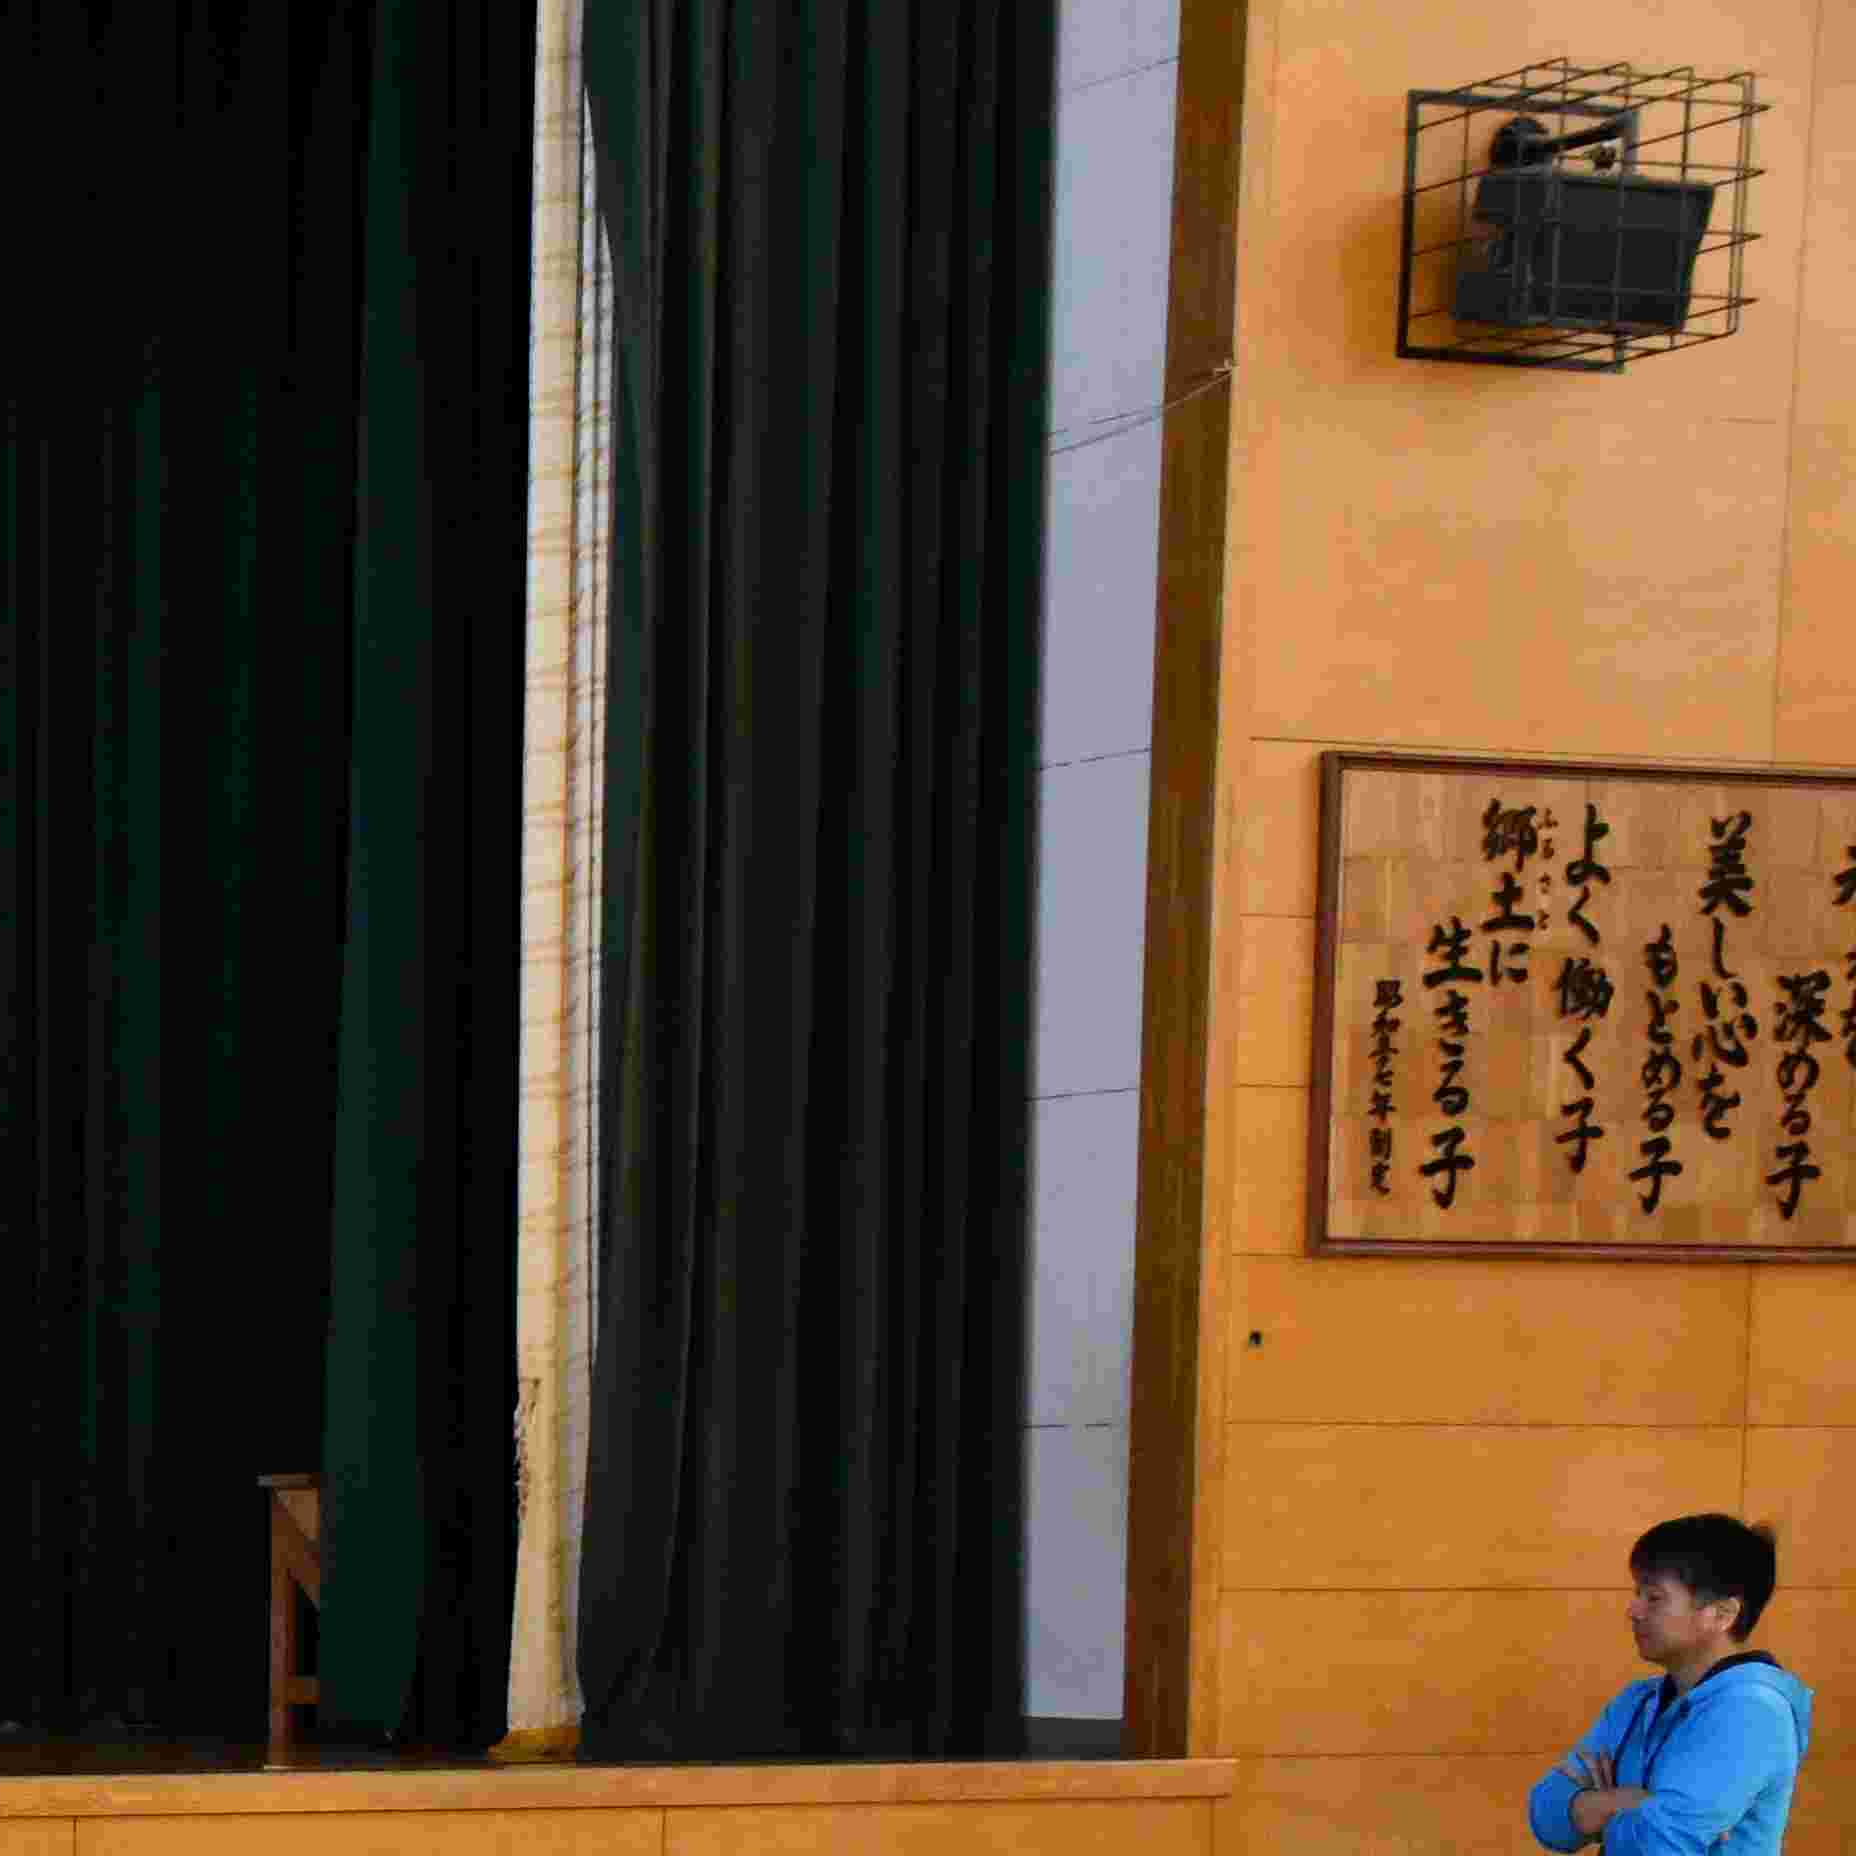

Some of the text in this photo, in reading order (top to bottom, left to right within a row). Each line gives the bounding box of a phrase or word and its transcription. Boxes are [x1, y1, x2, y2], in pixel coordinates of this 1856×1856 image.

[1418, 916, 1485, 1209] 生きる子
[1553, 803, 1615, 1175] よく働く子
[1628, 924, 1683, 1215] もとめる子
[1696, 811, 1758, 1140] 美しい心を
[1765, 970, 1832, 1221] 深める子
